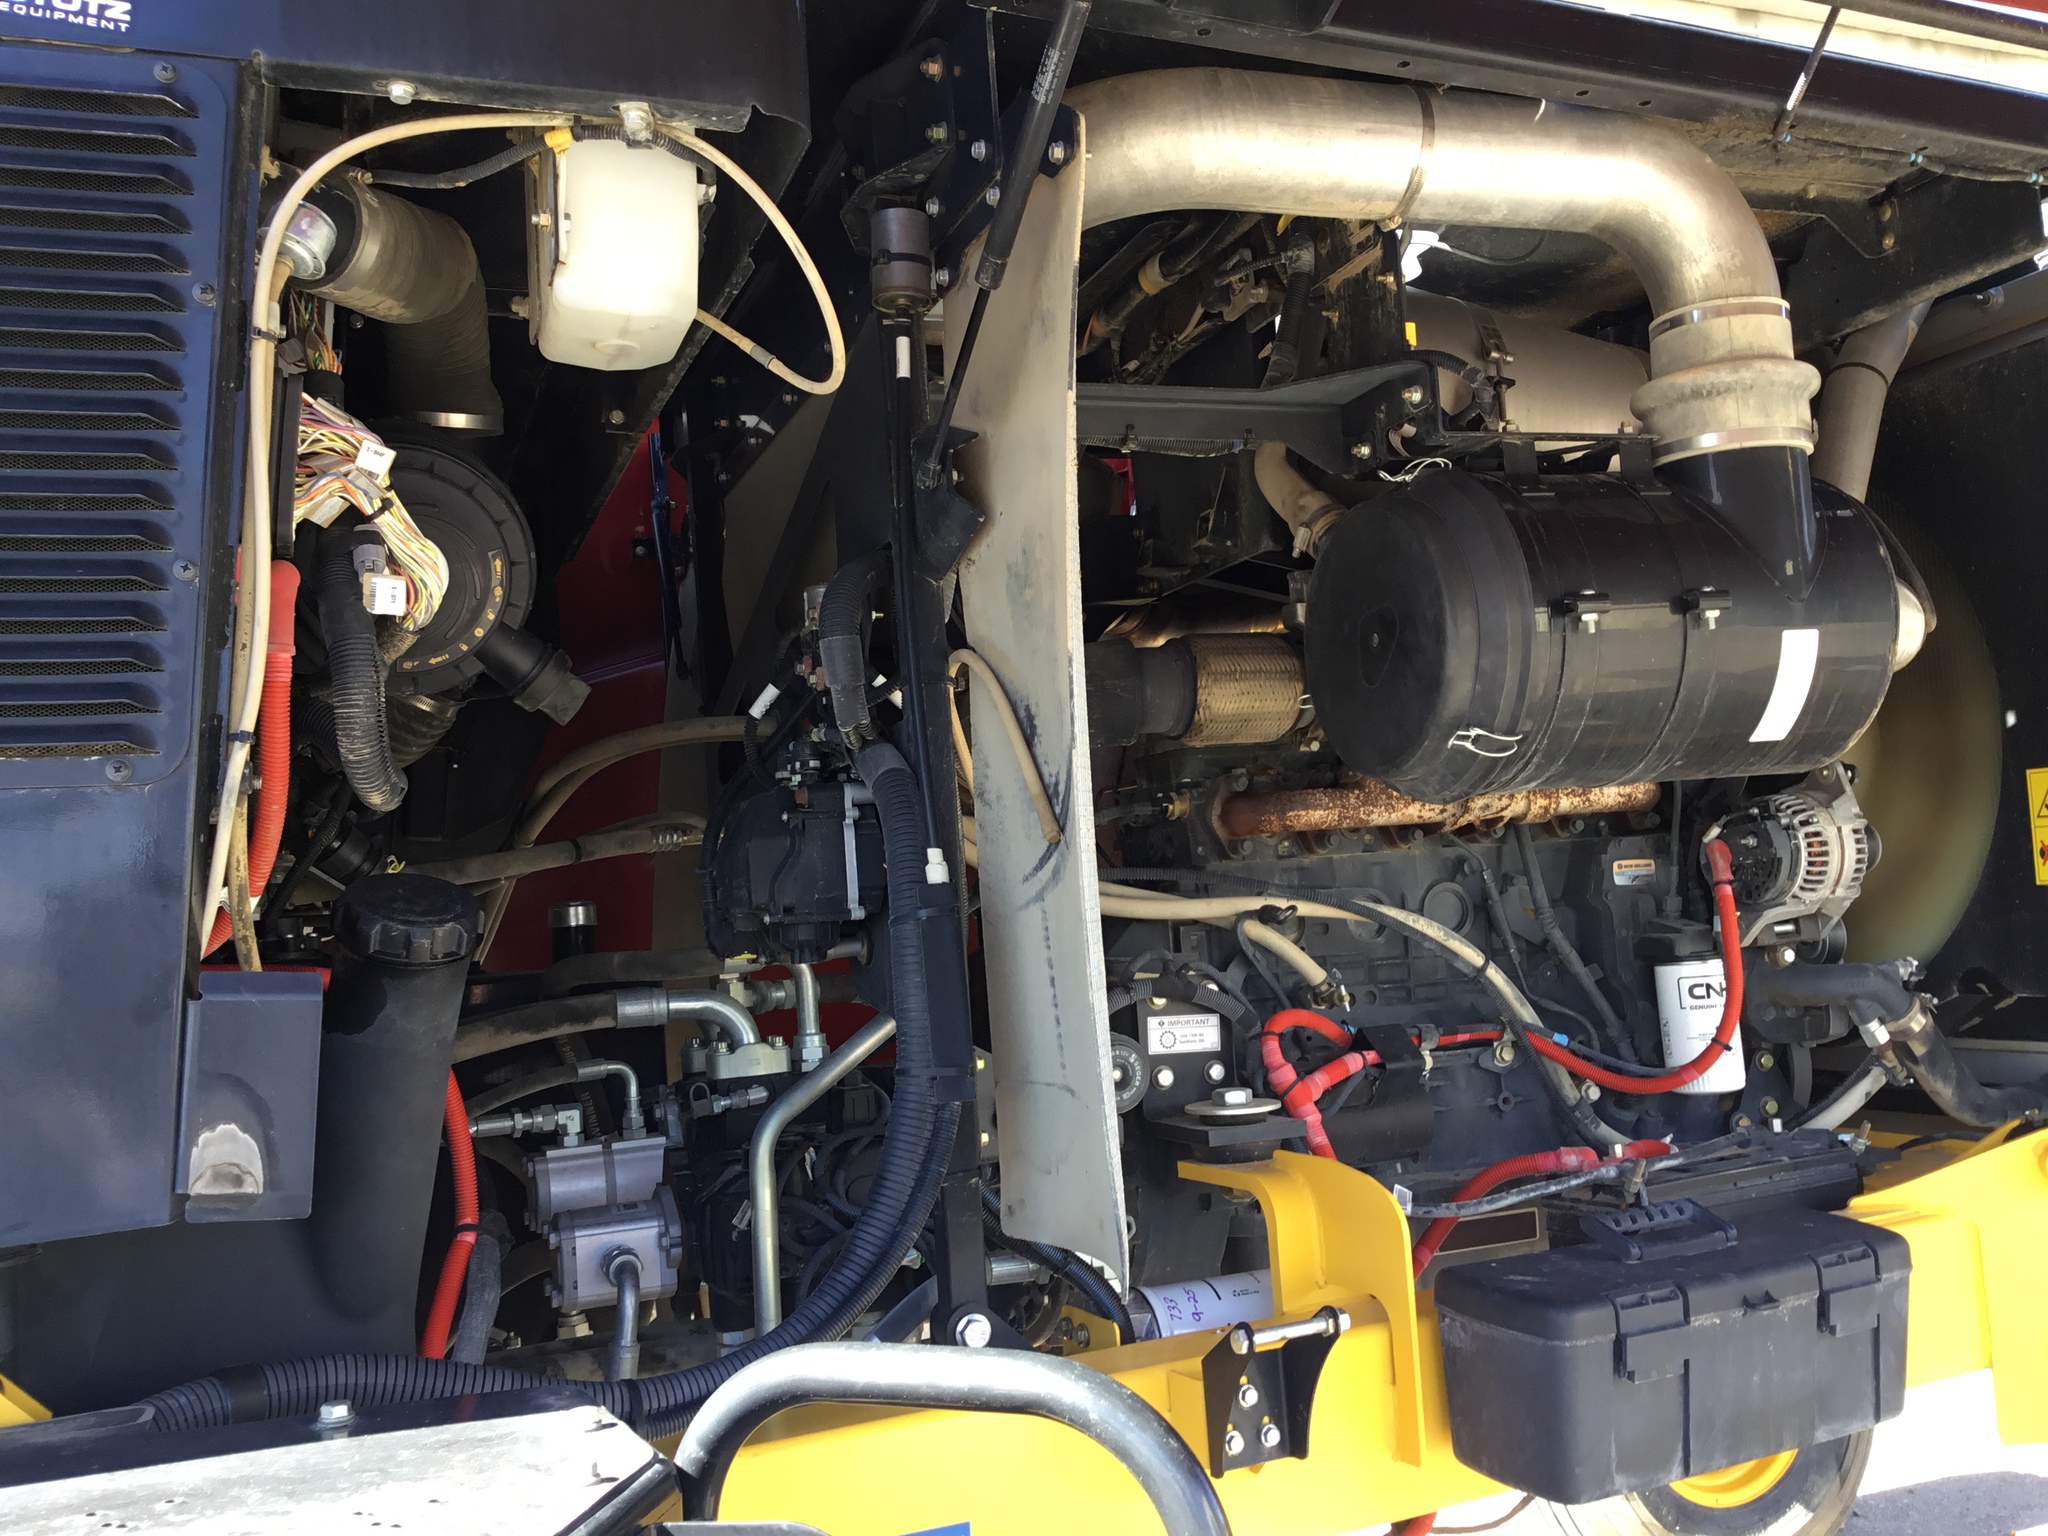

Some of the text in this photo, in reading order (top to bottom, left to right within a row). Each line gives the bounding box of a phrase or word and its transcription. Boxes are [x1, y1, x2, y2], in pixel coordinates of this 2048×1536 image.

[0, 1, 130, 32] EQUIPMENT
[8, 0, 131, 21] UTZ
[1690, 1003, 1718, 1011] GENUINE
[1167, 1018, 1210, 1027] IMPORTANT
[1134, 1061, 1142, 1086] SEGER
[1163, 1296, 1182, 1321] 733
[1183, 1286, 1204, 1322] 9-25
